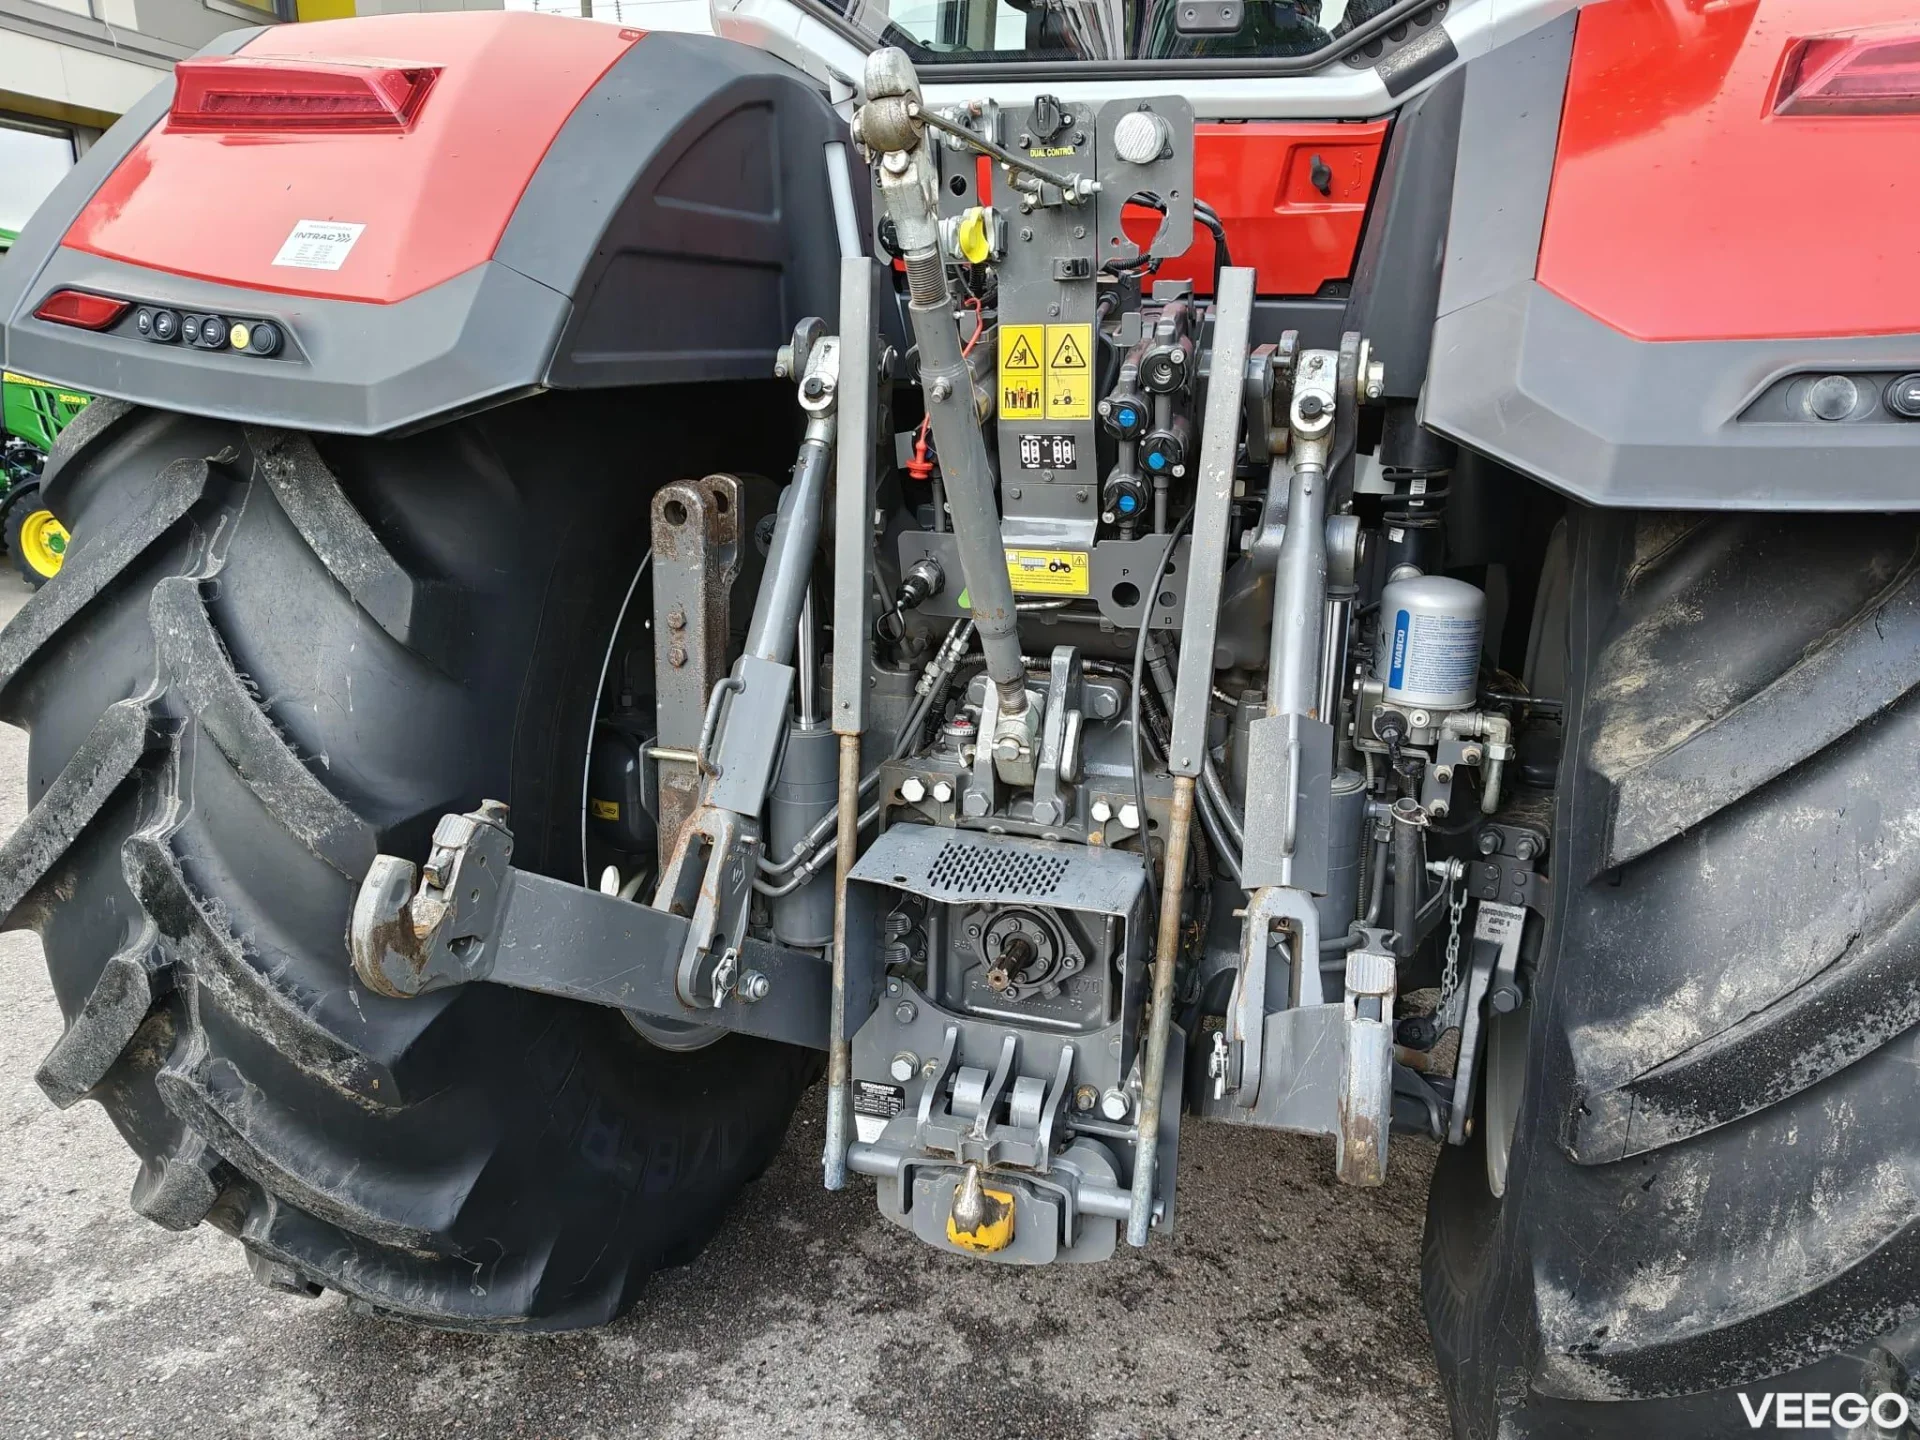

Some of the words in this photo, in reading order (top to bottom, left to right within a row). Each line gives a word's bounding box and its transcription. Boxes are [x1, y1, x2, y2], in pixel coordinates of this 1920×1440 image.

[1030, 147, 1046, 157] DUAL
[1046, 146, 1075, 157] CONTROL
[294, 231, 336, 241] INTRAC
[1122, 568, 1130, 576] P
[1394, 629, 1406, 669] WABCO
